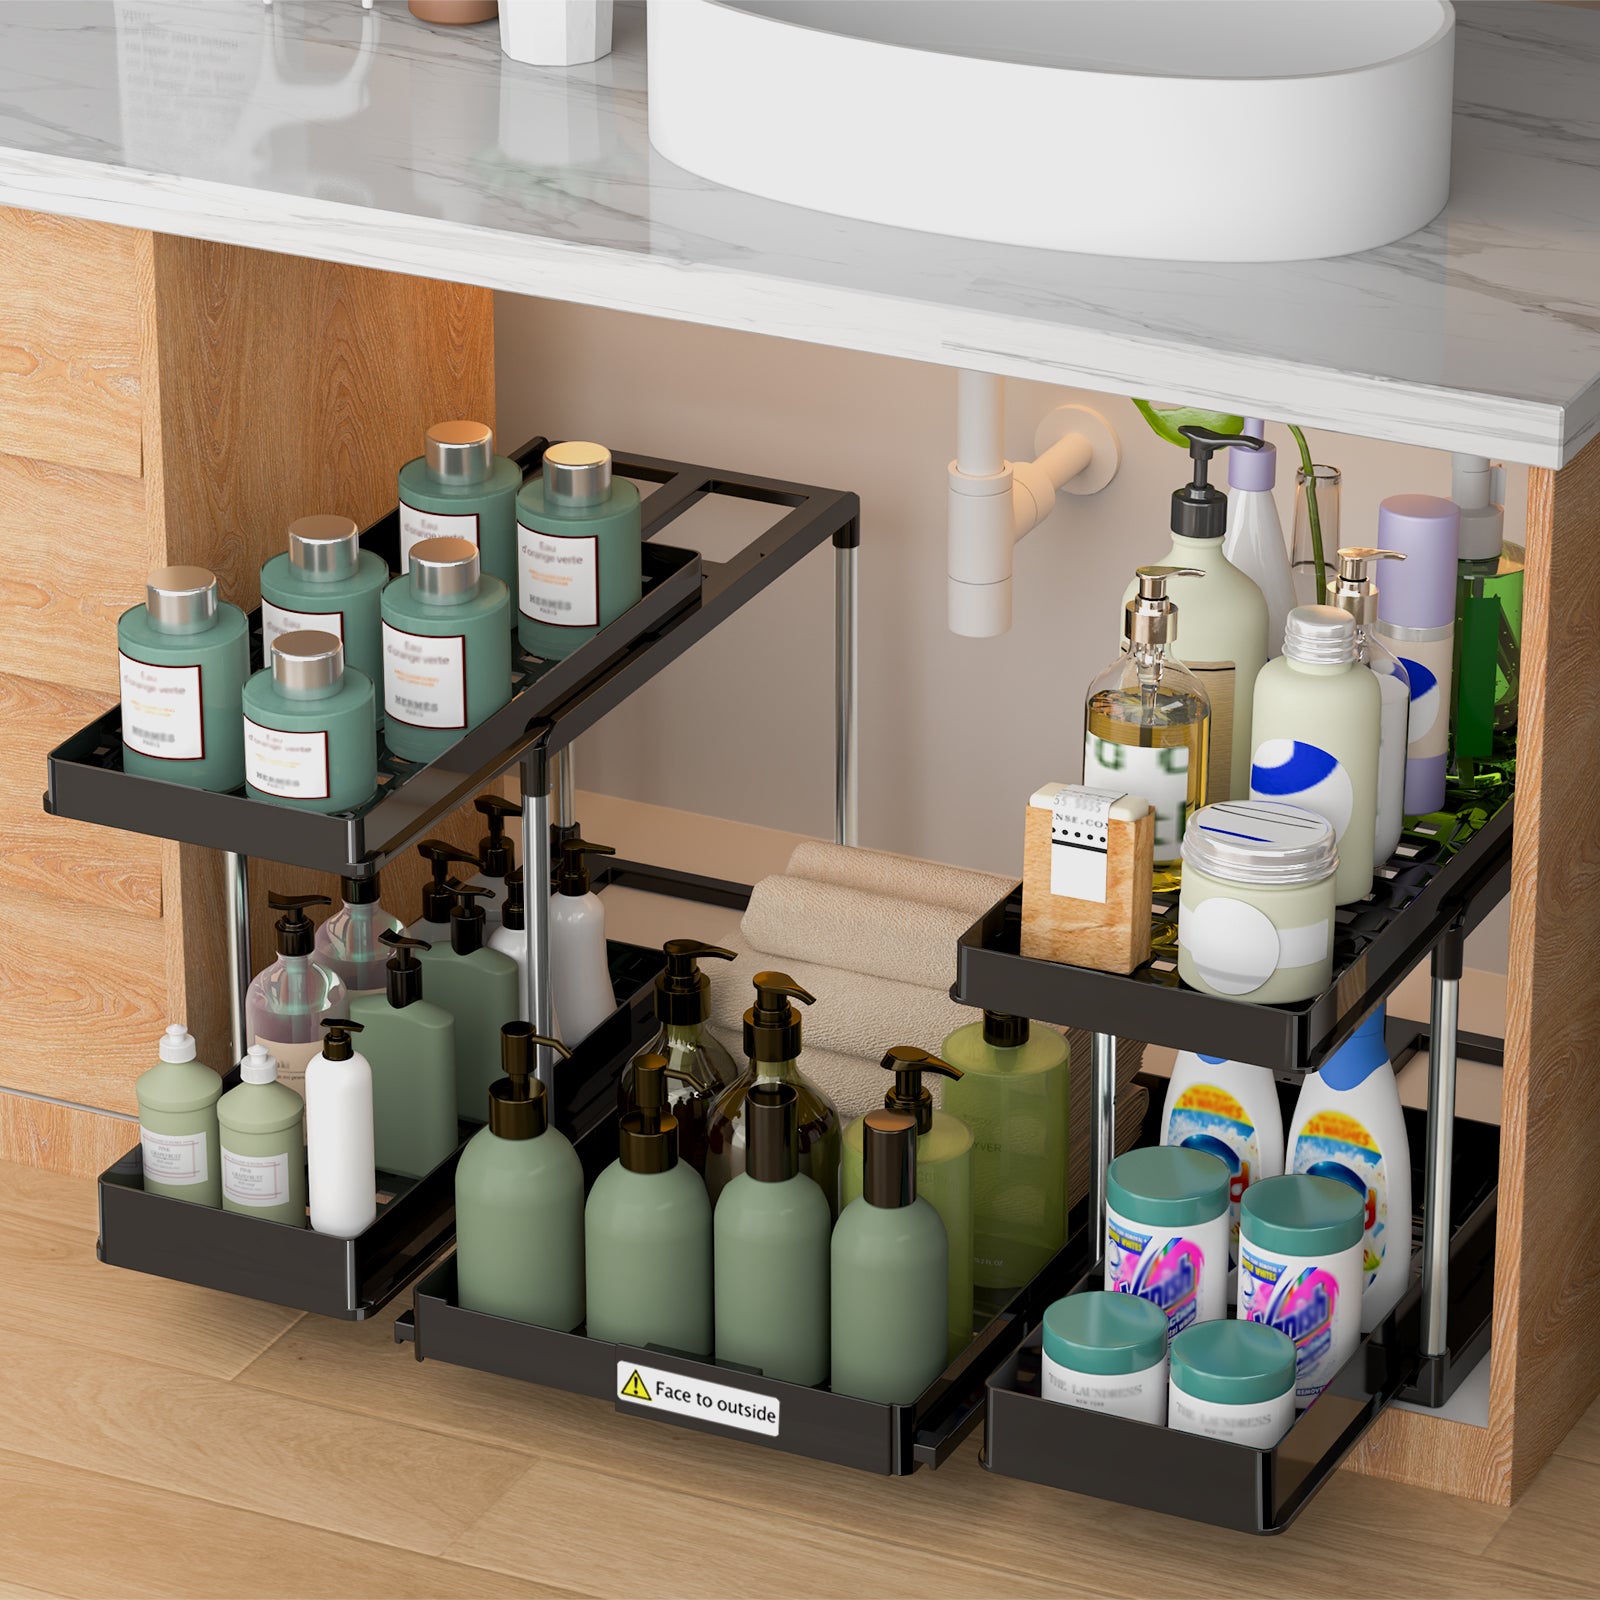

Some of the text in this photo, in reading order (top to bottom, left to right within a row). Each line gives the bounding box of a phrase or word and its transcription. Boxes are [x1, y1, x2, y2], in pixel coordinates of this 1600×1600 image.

[656, 1381, 777, 1424] Face to outside
